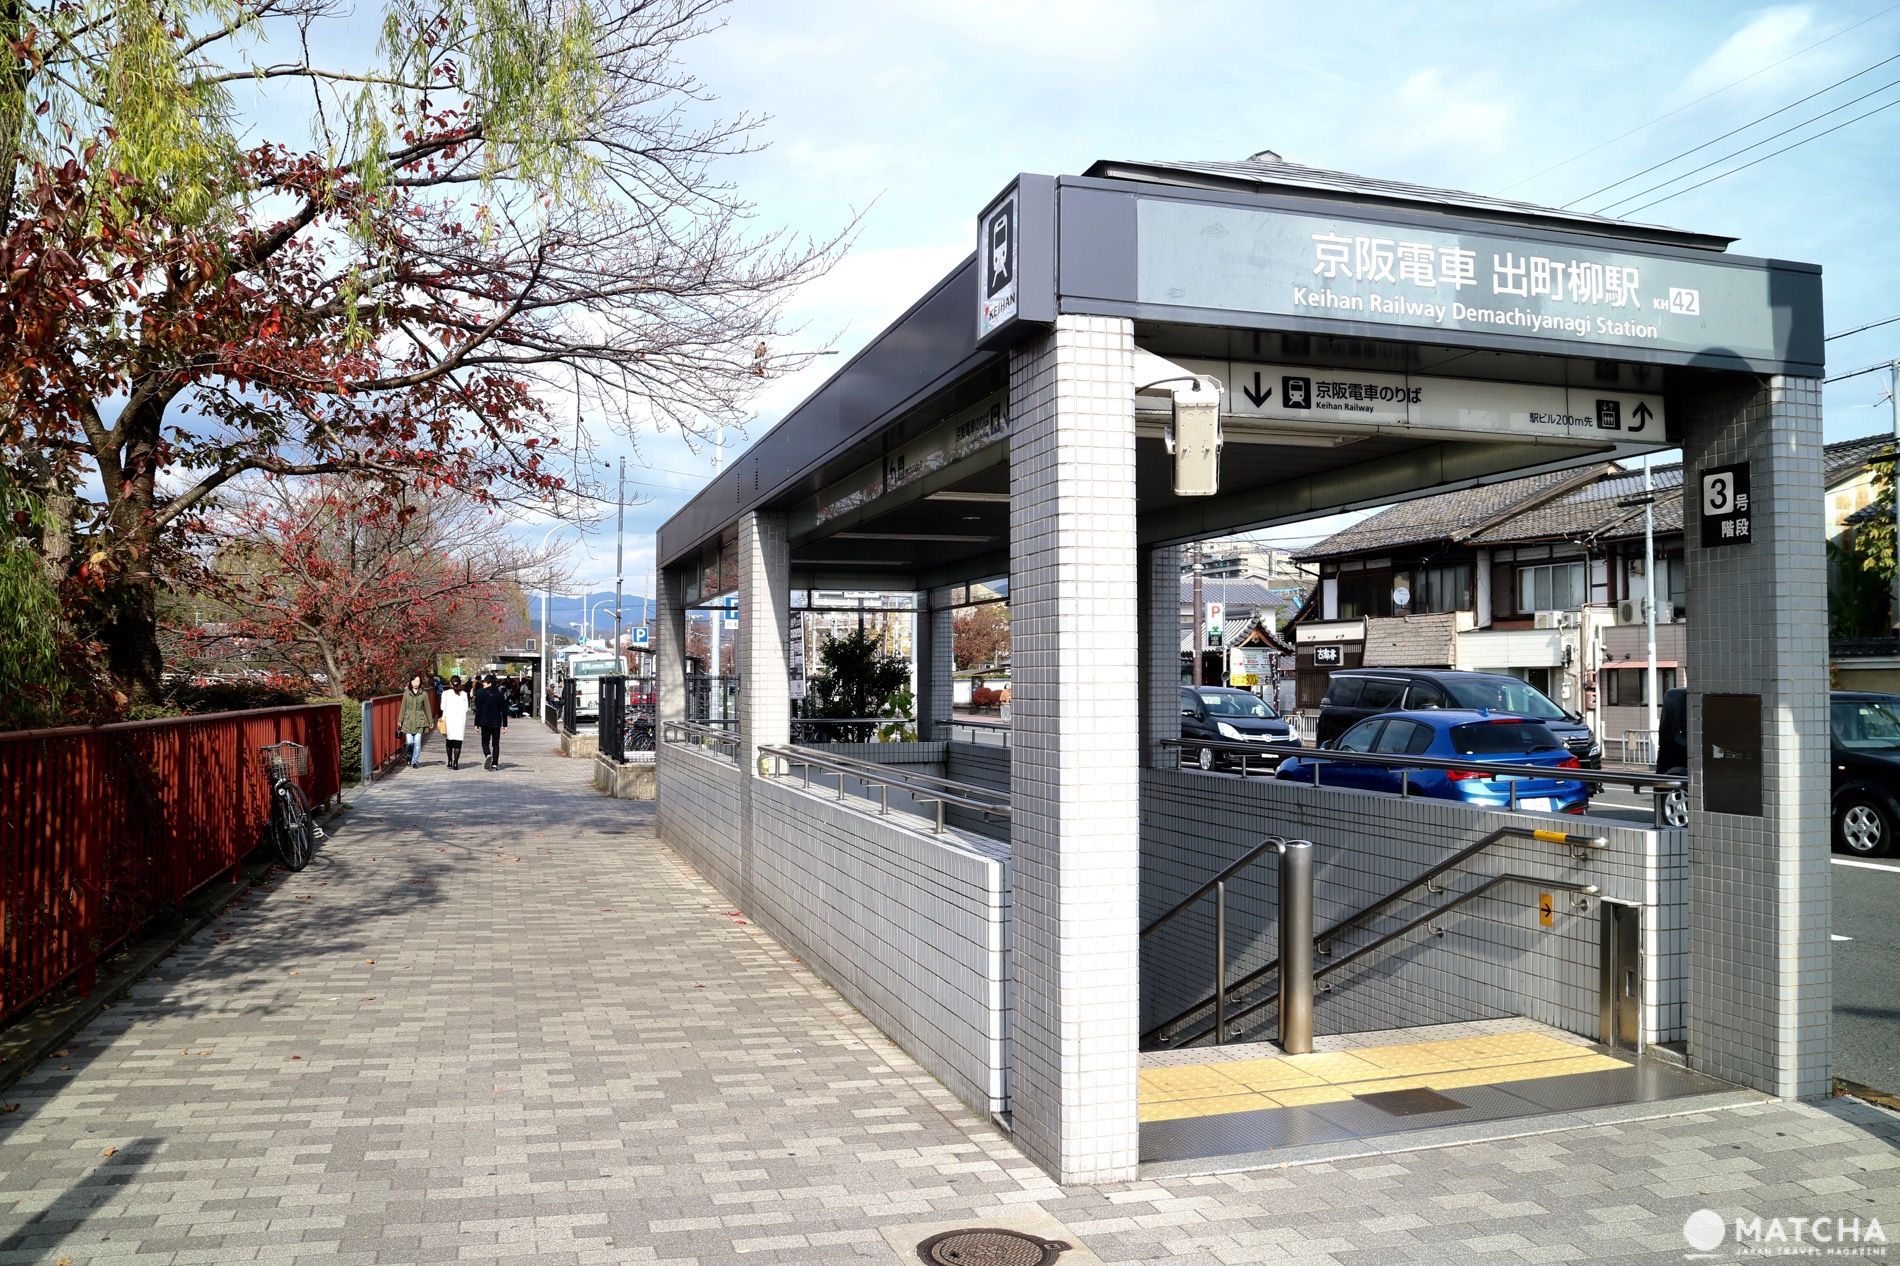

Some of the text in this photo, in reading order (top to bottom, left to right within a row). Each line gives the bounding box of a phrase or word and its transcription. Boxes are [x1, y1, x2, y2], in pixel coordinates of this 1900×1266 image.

[1311, 231, 1641, 309] 京阪電車 出町柳駅
[988, 292, 1015, 321] KEIHAN
[1653, 291, 1697, 313] KH 42
[1294, 287, 1657, 339] Keihan Railway Demachiyanagi Station
[1316, 381, 1422, 403] 京阪電車のりば
[1316, 402, 1374, 413] Keihan Railway
[1529, 412, 1593, 427] 駅ビル200m先
[1721, 518, 1749, 538] 階段
[1211, 605, 1221, 618] P
[636, 629, 646, 642] P
